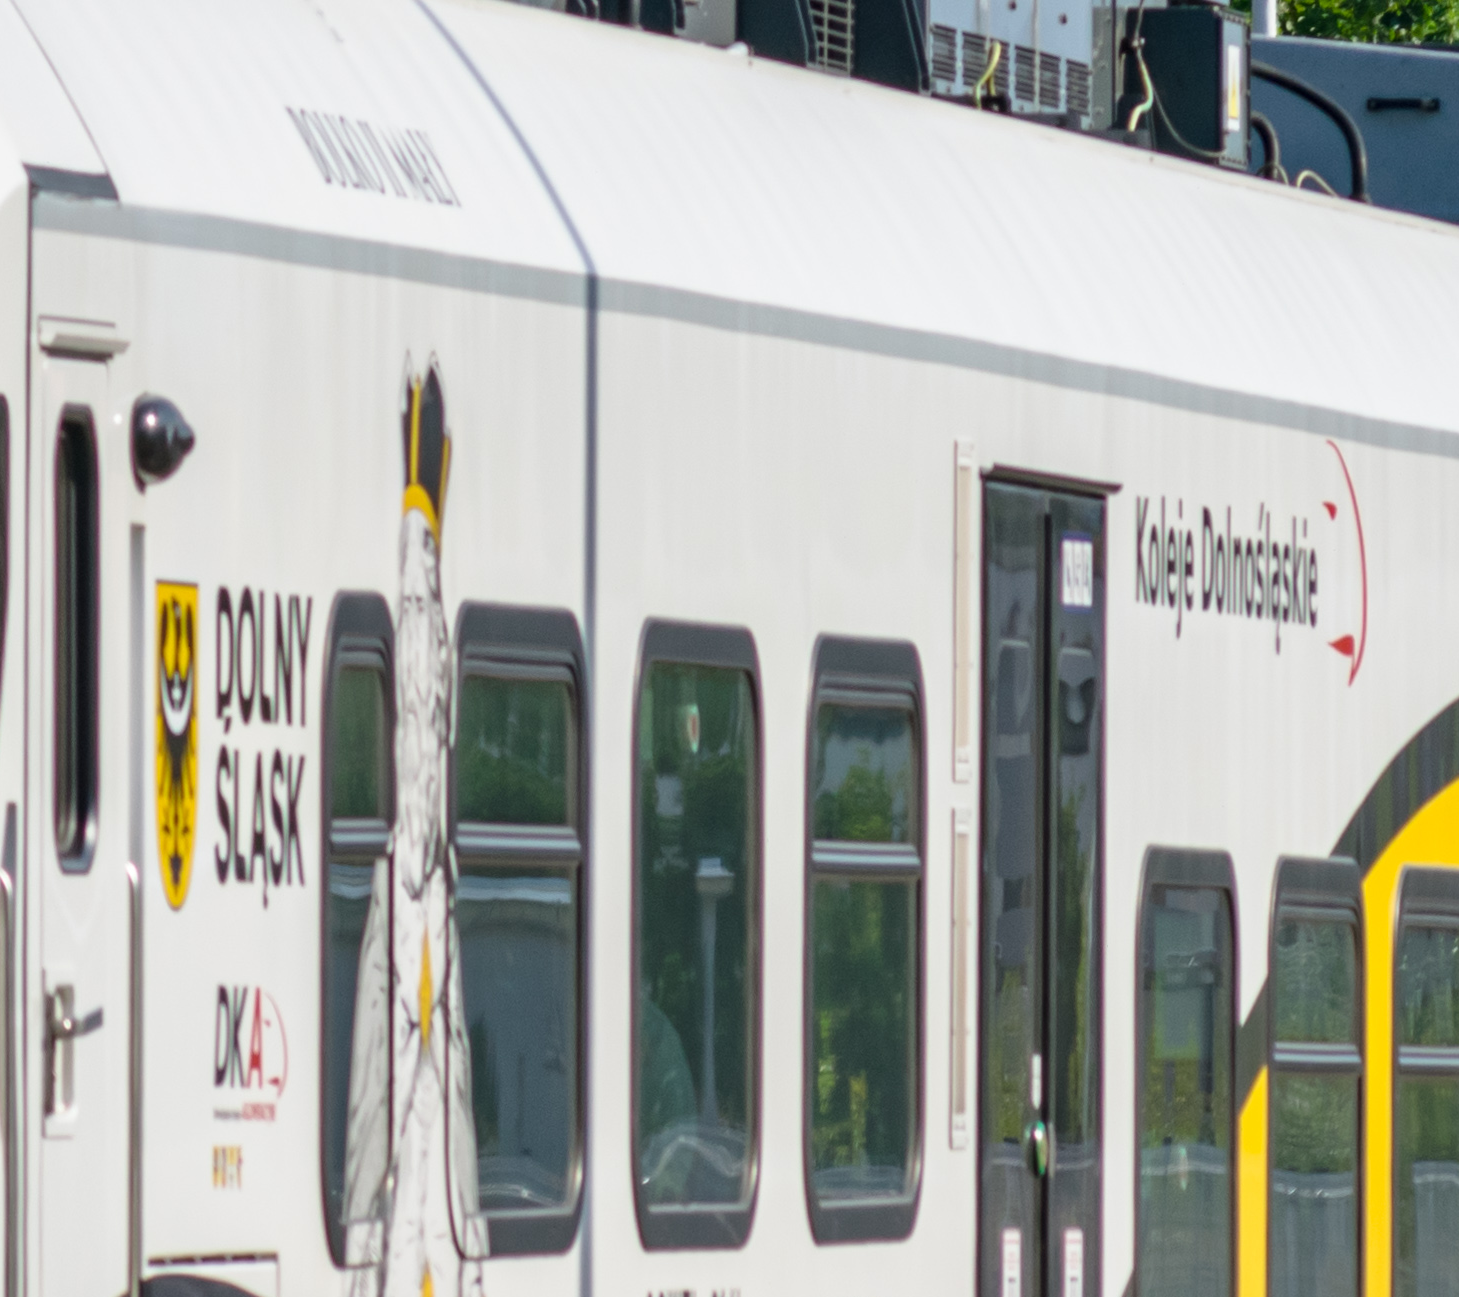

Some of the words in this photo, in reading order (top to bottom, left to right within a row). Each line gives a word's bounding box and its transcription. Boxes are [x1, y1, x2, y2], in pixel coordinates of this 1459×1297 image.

[1135, 494, 1194, 640] Koleje
[1201, 501, 1319, 656] Dolnośląskie
[216, 585, 313, 728] DOLNY
[213, 984, 263, 1089] DKA
